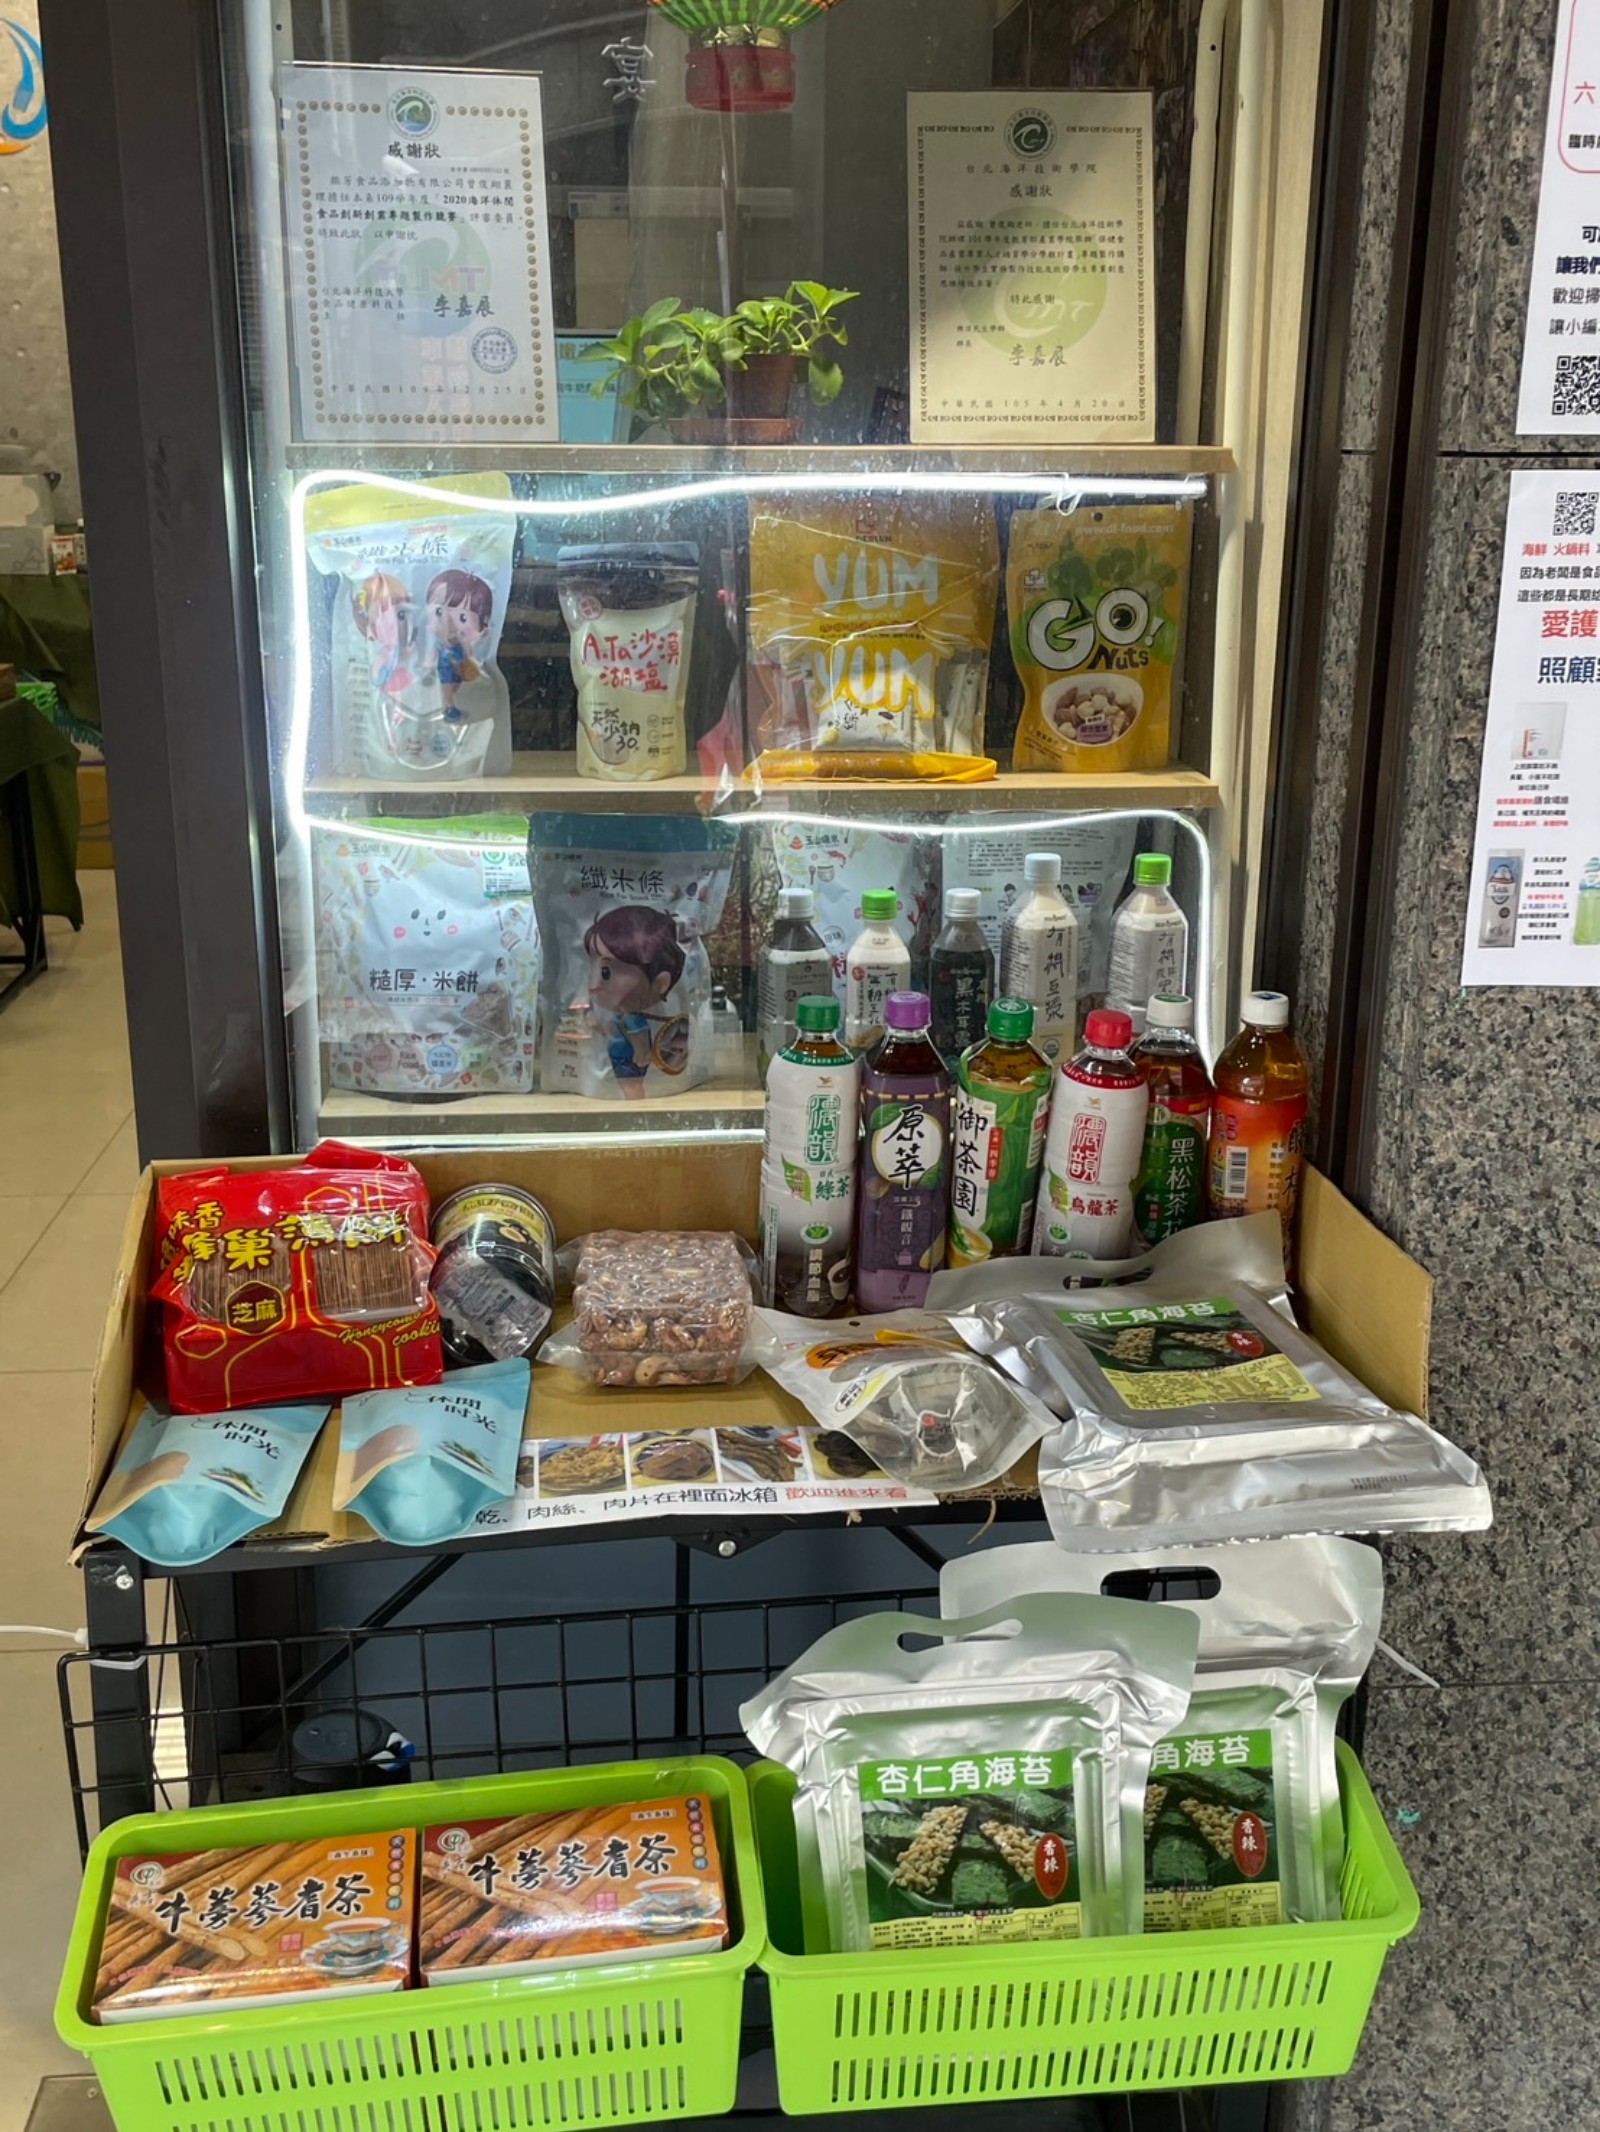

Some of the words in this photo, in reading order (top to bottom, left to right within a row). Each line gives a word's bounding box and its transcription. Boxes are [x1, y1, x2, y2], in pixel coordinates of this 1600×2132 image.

[1574, 81, 1596, 104] 六
[388, 142, 441, 159] 感謝狀
[1568, 134, 1600, 149] 臨時
[966, 163, 1098, 174] 台北海洋技術學院
[1010, 184, 1053, 198] 感謝狀
[1582, 225, 1600, 243] 可
[433, 294, 495, 318] 李嘉展
[1552, 287, 1600, 305] 歡迎掃
[1549, 318, 1600, 336] 讓小編
[1009, 344, 1067, 367] 李嘉展
[1522, 543, 1548, 557] 海鮮
[814, 553, 940, 612] YUM
[1541, 609, 1599, 638] 愛護
[1086, 644, 1149, 670] Nuts
[814, 645, 936, 720] YUM
[580, 866, 665, 894] 纖米條
[808, 1096, 840, 1164] 濃韻
[883, 1104, 925, 1190] 原萃
[954, 1102, 988, 1217] 御茶園
[1069, 1114, 1105, 1182] 濃韻
[816, 1176, 850, 1201] 綠茶
[1071, 1197, 1119, 1217] 烏龍茶
[231, 1300, 277, 1323] 芝麻
[1071, 1301, 1215, 1326] 杏仁角海苔
[603, 1486, 778, 1511] 肉片在裡面冰箱
[786, 1486, 907, 1501] 歡迎進來看
[1151, 1735, 1250, 1771] 角海苔
[876, 1756, 1052, 1795] 杏仁角海苔
[1241, 1817, 1258, 1851] 香辣
[1043, 1839, 1059, 1873] 香辣
